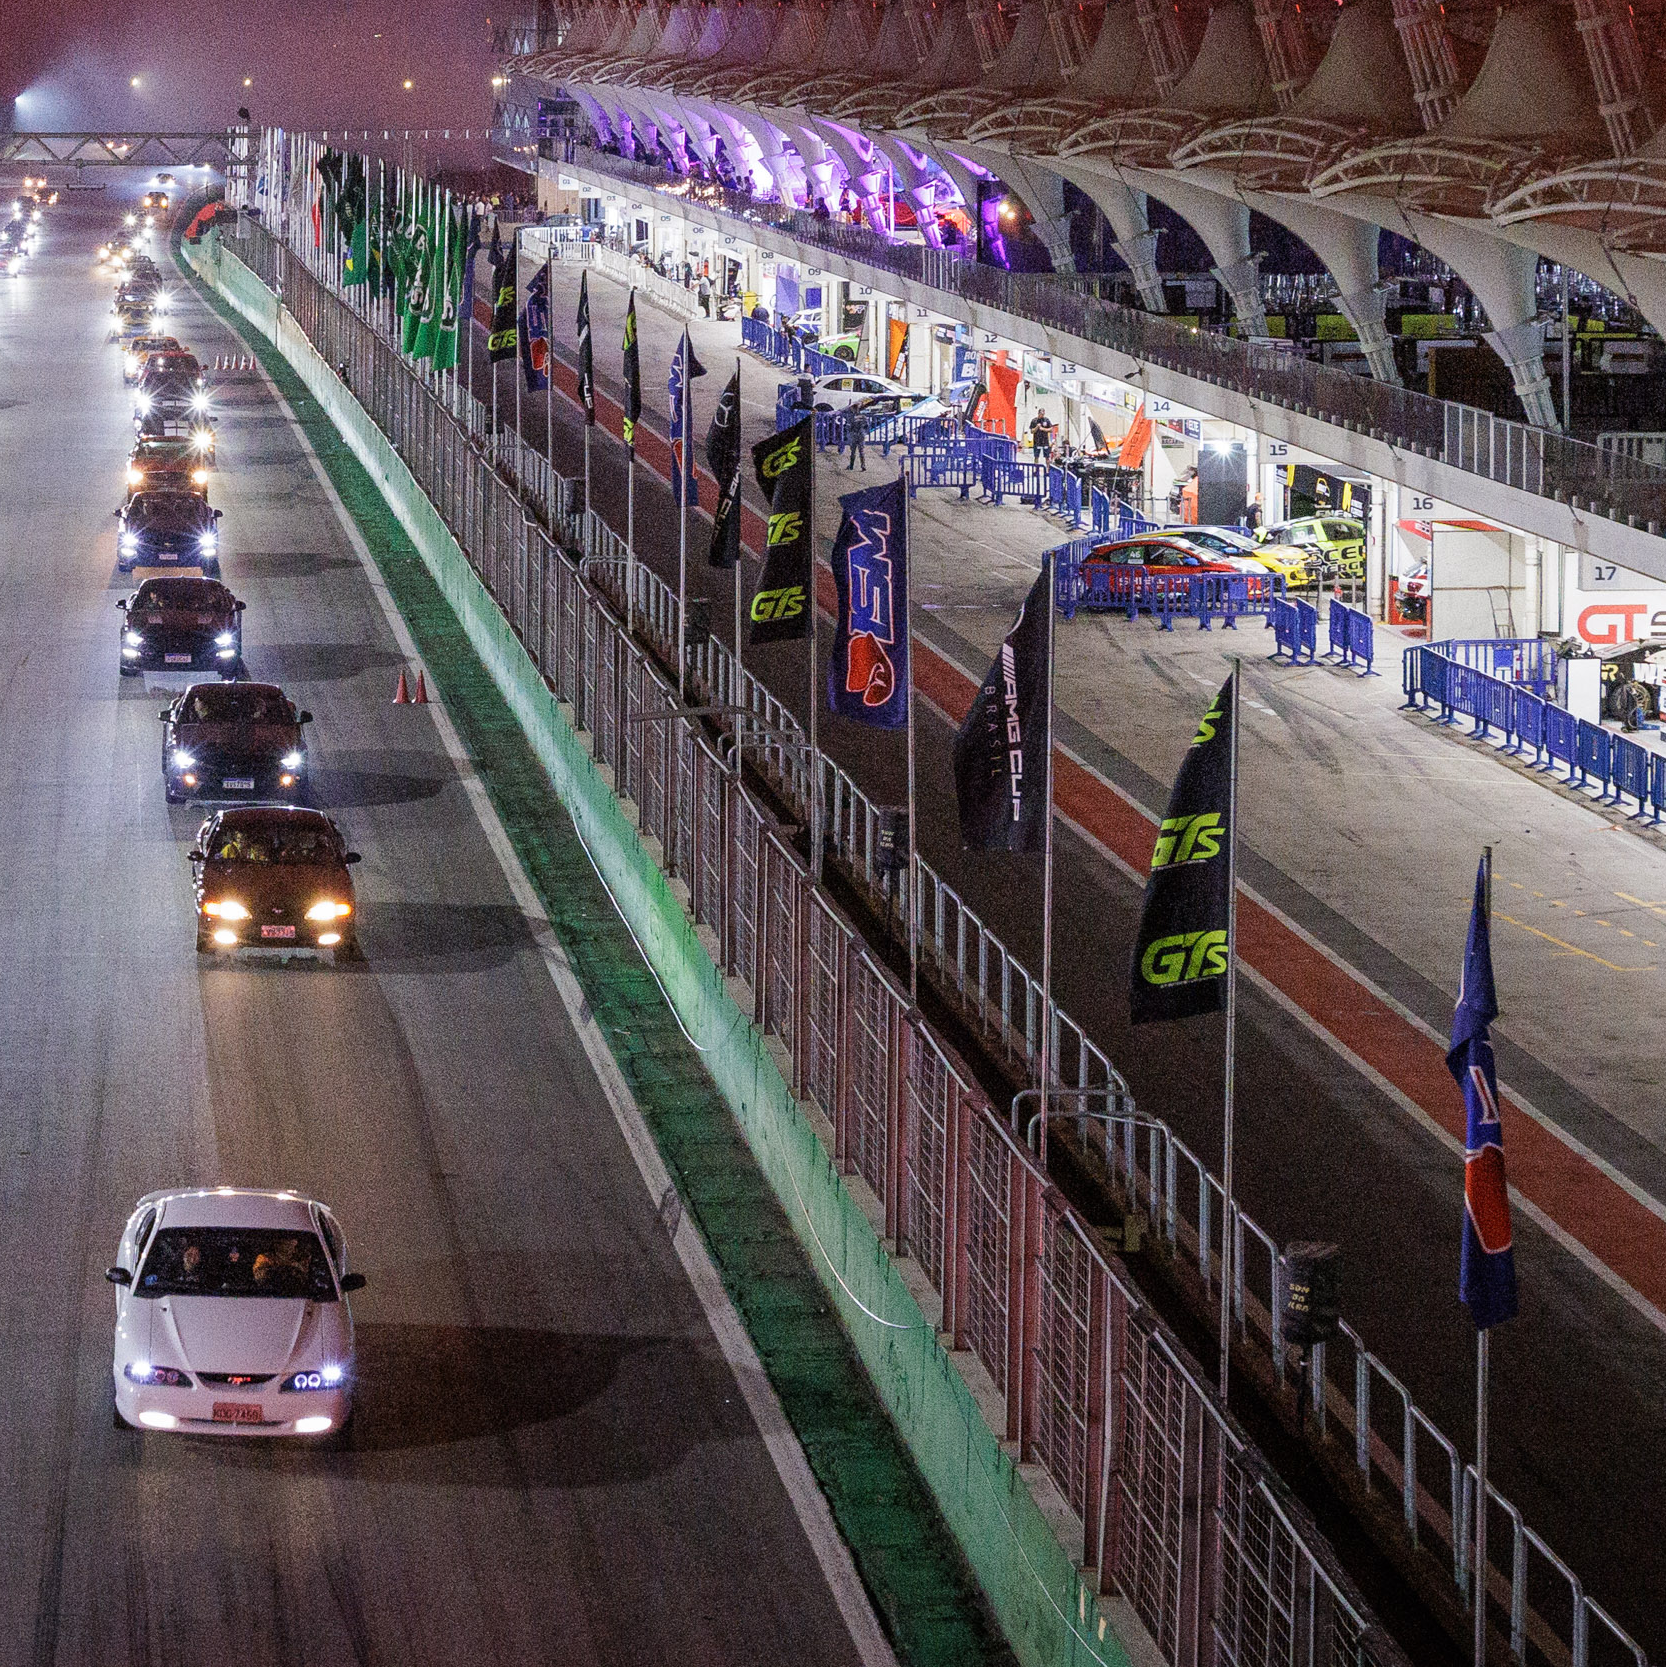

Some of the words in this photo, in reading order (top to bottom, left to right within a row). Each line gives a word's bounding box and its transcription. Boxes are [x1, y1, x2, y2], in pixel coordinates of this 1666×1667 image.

[761, 251, 773, 259] 08
[807, 268, 821, 276] 09
[859, 287, 872, 295] 10
[916, 309, 928, 317] 11
[984, 335, 998, 343] 12
[1061, 364, 1076, 373] 13
[1153, 401, 1171, 411] 14
[1270, 445, 1288, 456] 15
[1412, 497, 1434, 511] 16
[1129, 550, 1140, 558] 46
[1594, 566, 1617, 581] 17
[750, 586, 807, 622] GTs
[1577, 604, 1647, 644] GT
[984, 684, 1003, 778] BRASIL
[1009, 749, 1023, 821] CUP
[1141, 930, 1229, 985] GTs
